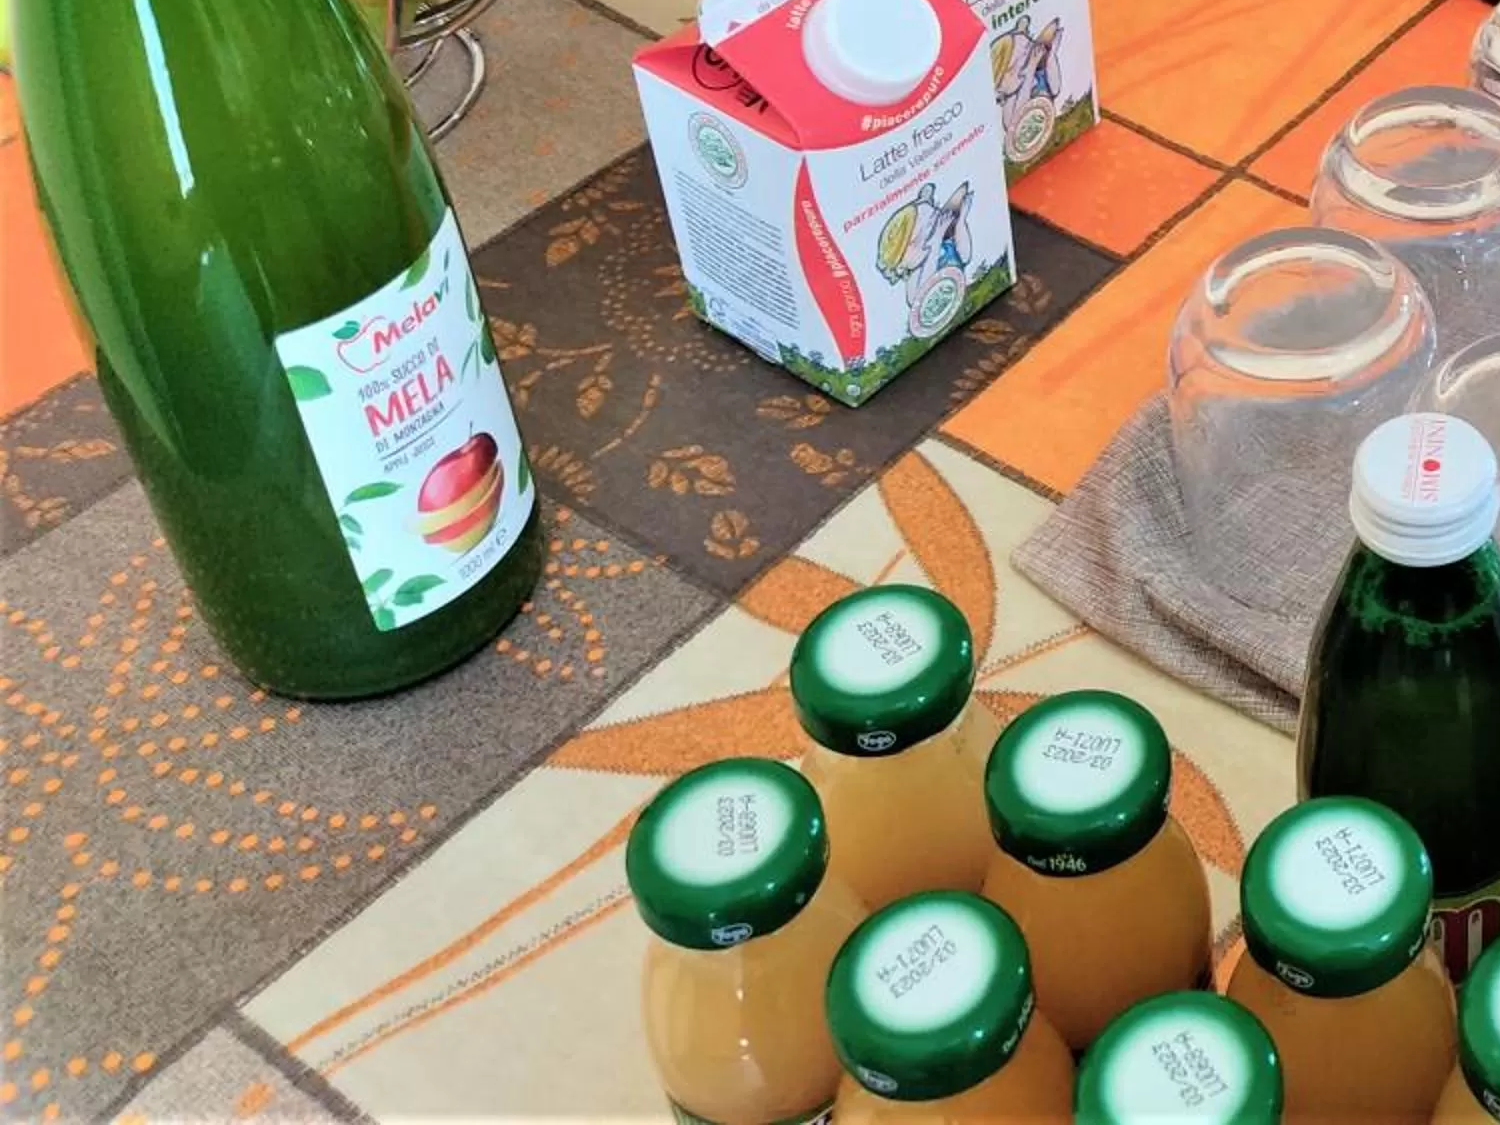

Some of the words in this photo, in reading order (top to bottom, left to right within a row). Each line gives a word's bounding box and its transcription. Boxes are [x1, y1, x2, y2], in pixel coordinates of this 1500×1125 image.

[860, 65, 945, 132] #piacerepuro
[859, 141, 909, 183] Latte
[911, 100, 964, 149] fresco
[843, 168, 932, 234] parzialmente
[932, 123, 986, 170] scremato
[363, 353, 456, 438] MELA
[390, 349, 426, 385] SUCCO
[375, 436, 390, 454] DI
[393, 399, 447, 444] MONTAGNA
[1042, 744, 1113, 771] 03/2023
[717, 795, 735, 857] 03/2023
[1049, 856, 1088, 872] 1946
[1315, 835, 1367, 896] 03/2023
[889, 939, 958, 1000] 03/2023
